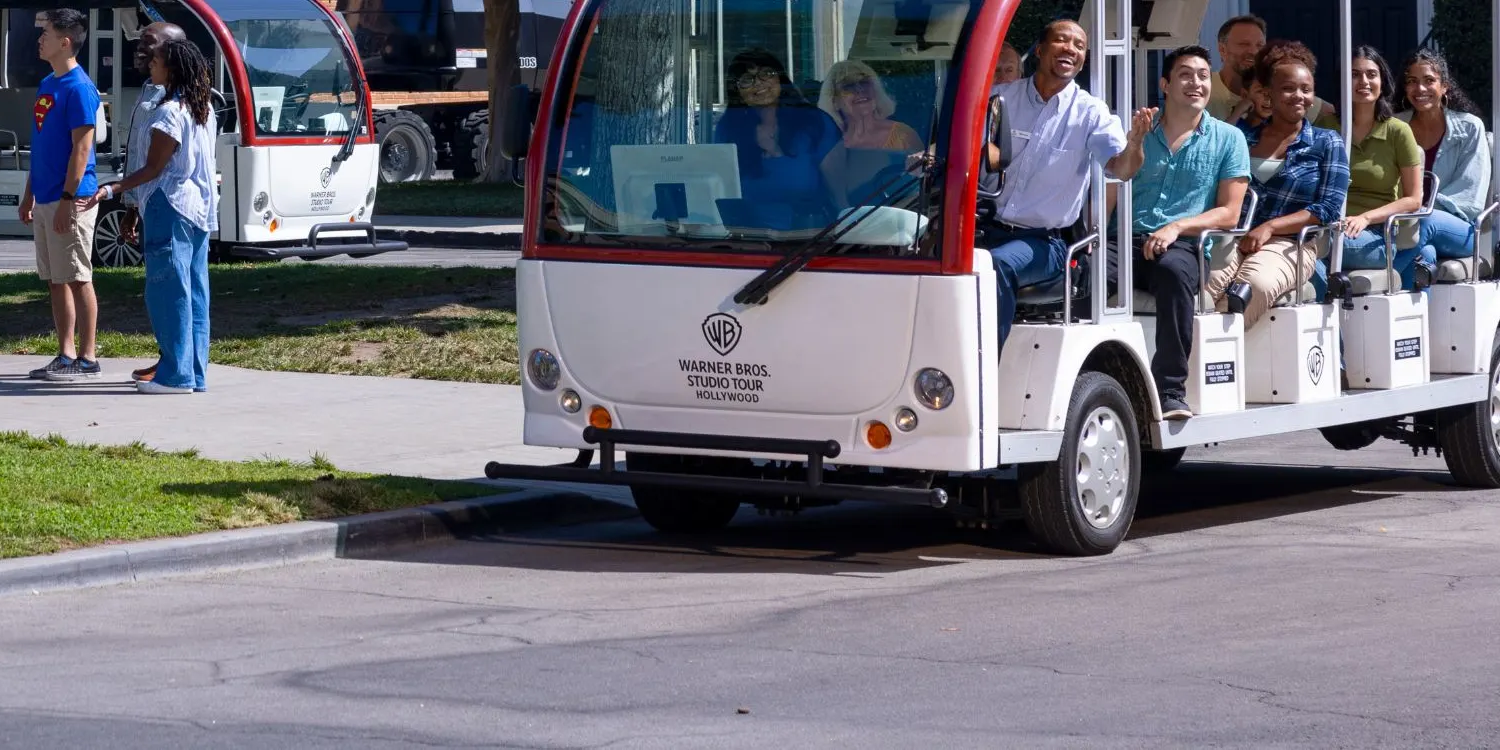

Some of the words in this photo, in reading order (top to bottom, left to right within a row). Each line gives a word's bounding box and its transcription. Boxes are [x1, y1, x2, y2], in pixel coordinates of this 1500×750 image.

[707, 319, 736, 348] WB
[678, 359, 732, 374] WARNER
[735, 363, 771, 377] BROS.
[687, 375, 730, 389] STUDIO
[731, 378, 764, 391] TOUR
[696, 390, 759, 403] HOLLYWOOD
